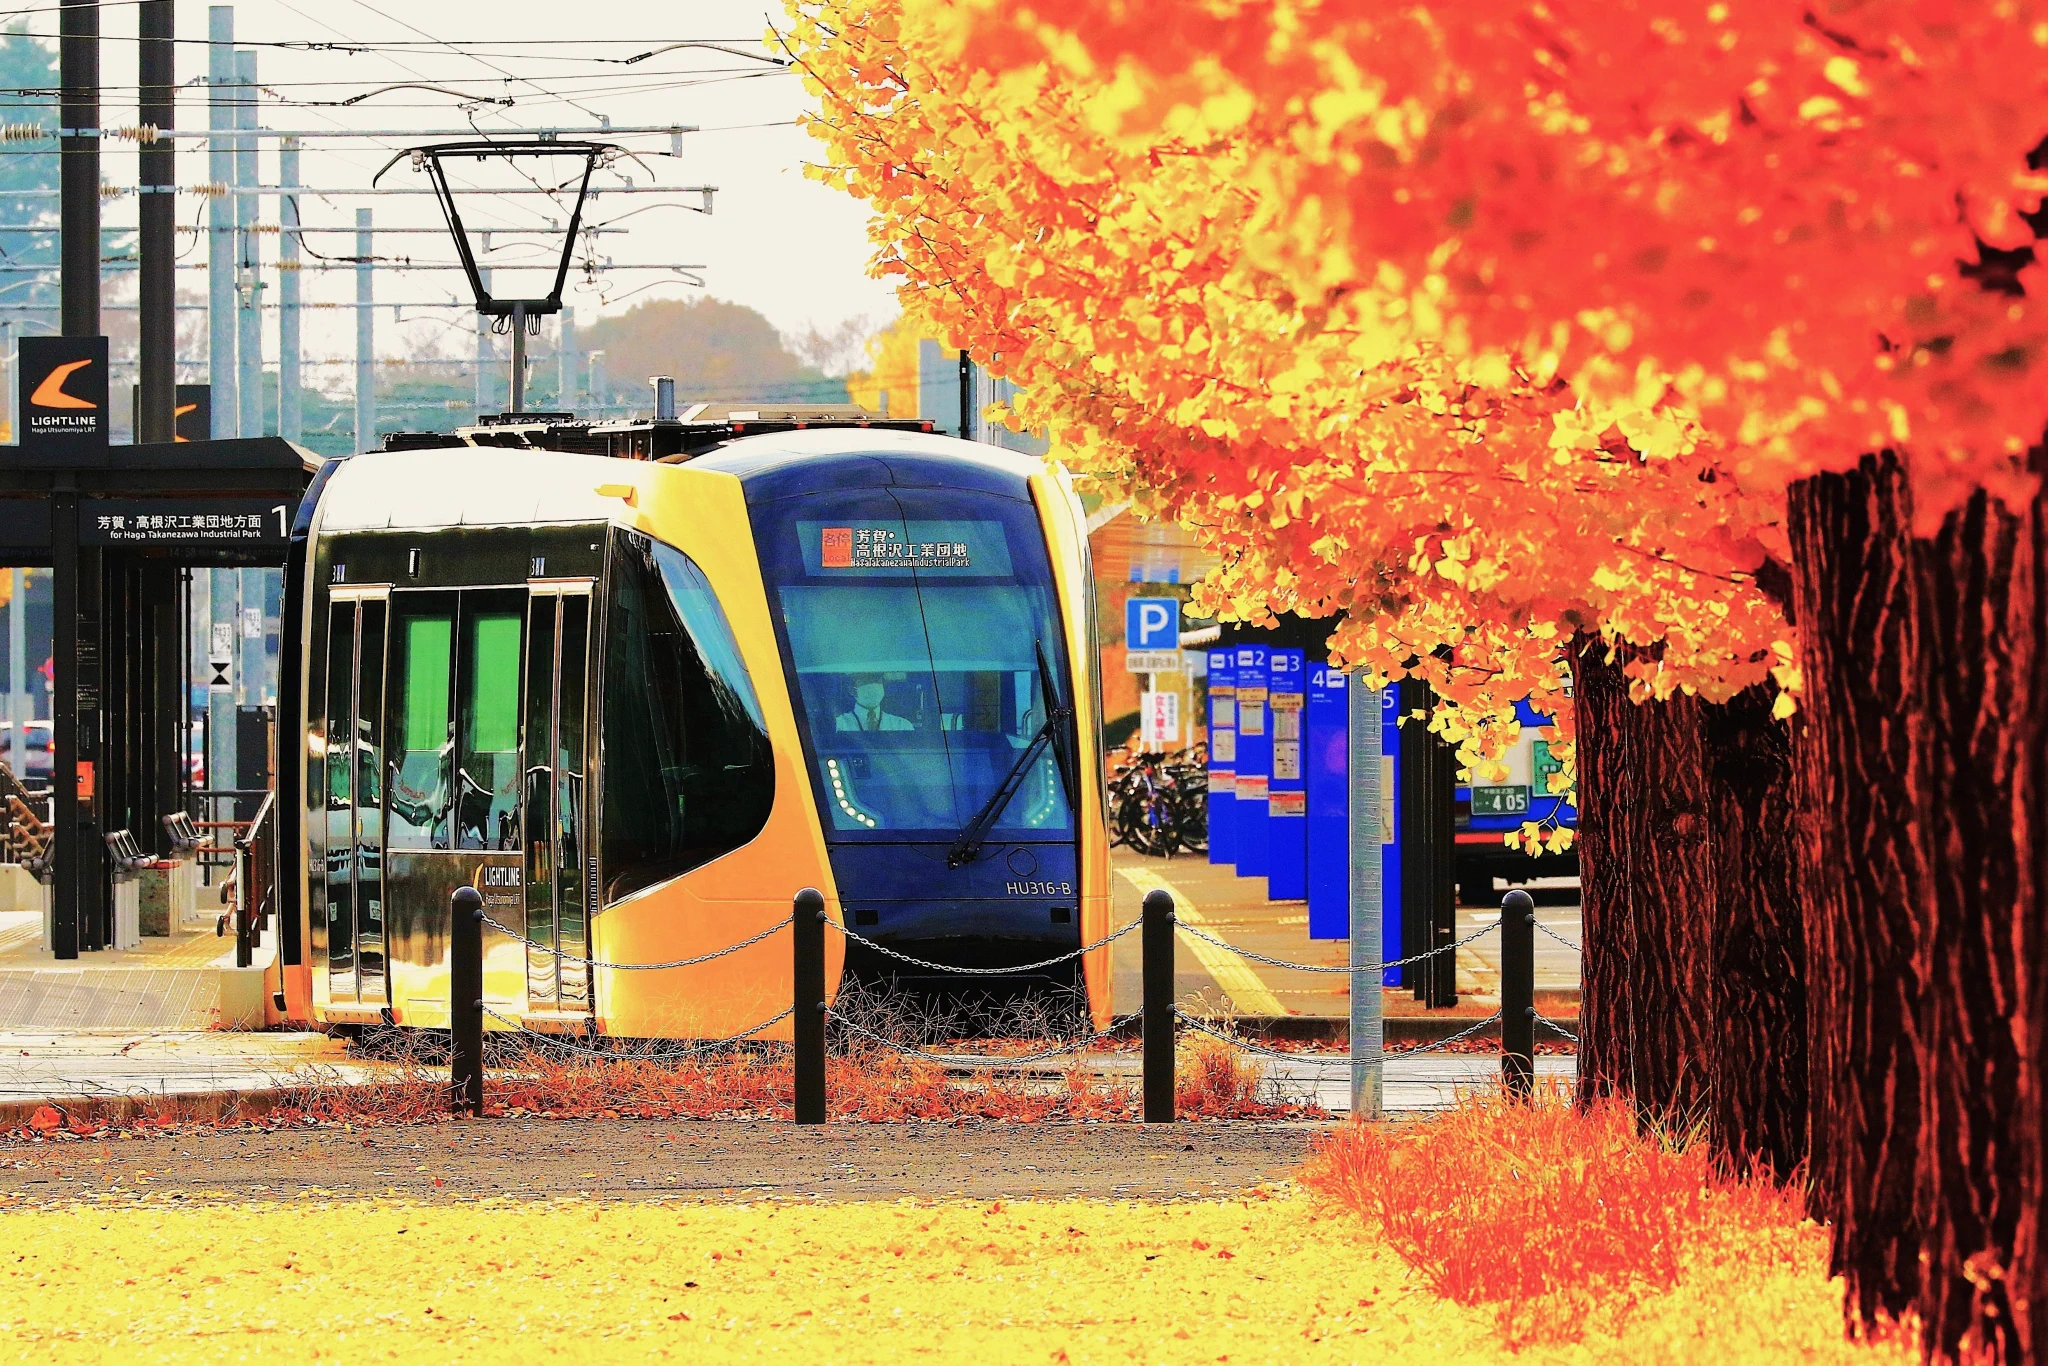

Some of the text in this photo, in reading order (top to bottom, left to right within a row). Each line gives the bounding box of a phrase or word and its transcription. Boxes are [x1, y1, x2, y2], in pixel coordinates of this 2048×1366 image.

[31, 416, 96, 426] LIGHTLINE
[98, 514, 262, 530] 芳賀・高根沢工業団地方面
[271, 505, 287, 538] 1
[110, 530, 261, 540] for Haga Takanezawa Industrial Park
[824, 552, 850, 563] Local
[856, 543, 967, 558] 高根沢工業団地
[1140, 603, 1169, 645] P
[1228, 654, 1235, 668] 1
[1255, 650, 1265, 666] 2
[1289, 655, 1300, 672] 3
[1312, 670, 1325, 688] 4
[1382, 689, 1395, 708] 5
[485, 867, 520, 886] LIGHTLINE
[1006, 882, 1072, 895] HU316-B
